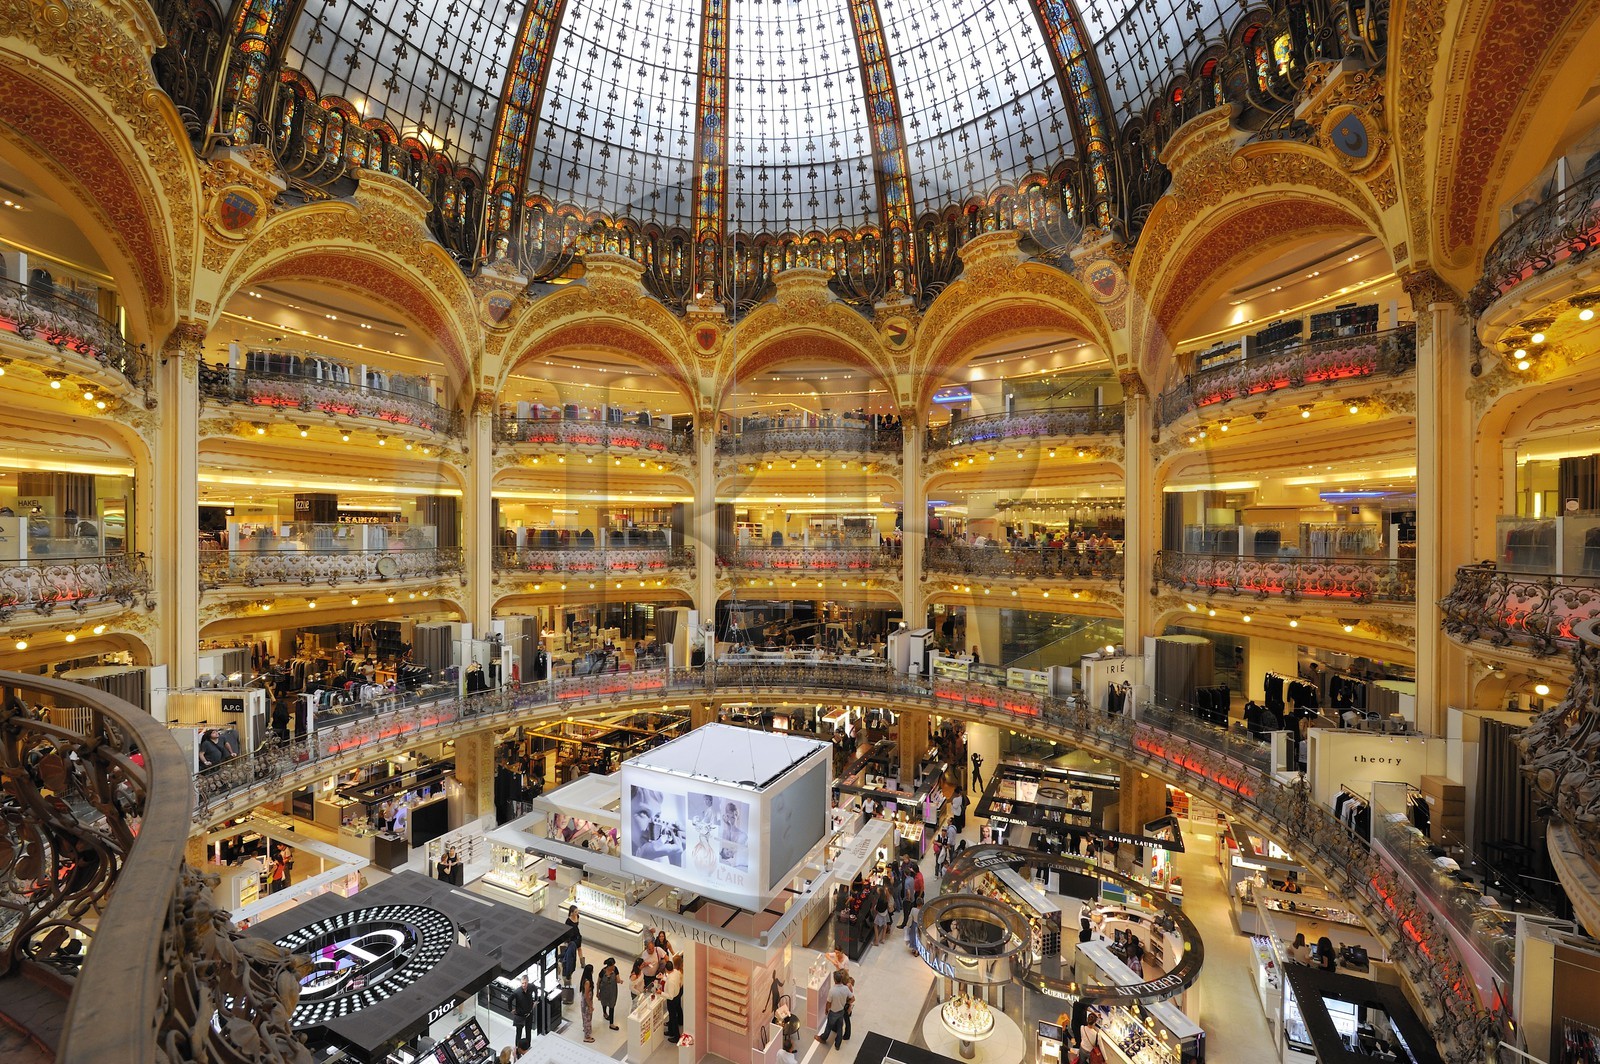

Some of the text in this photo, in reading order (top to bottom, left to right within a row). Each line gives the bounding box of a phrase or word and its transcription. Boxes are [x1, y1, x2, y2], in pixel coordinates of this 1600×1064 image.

[1354, 755, 1402, 766] theory
[1108, 835, 1163, 849] RALPH LAUREN
[974, 856, 1026, 868] GUERLAIN
[650, 914, 737, 954] NINA RICCI
[1042, 988, 1080, 1002] GUERLAIN
[428, 998, 456, 1024] Dior
